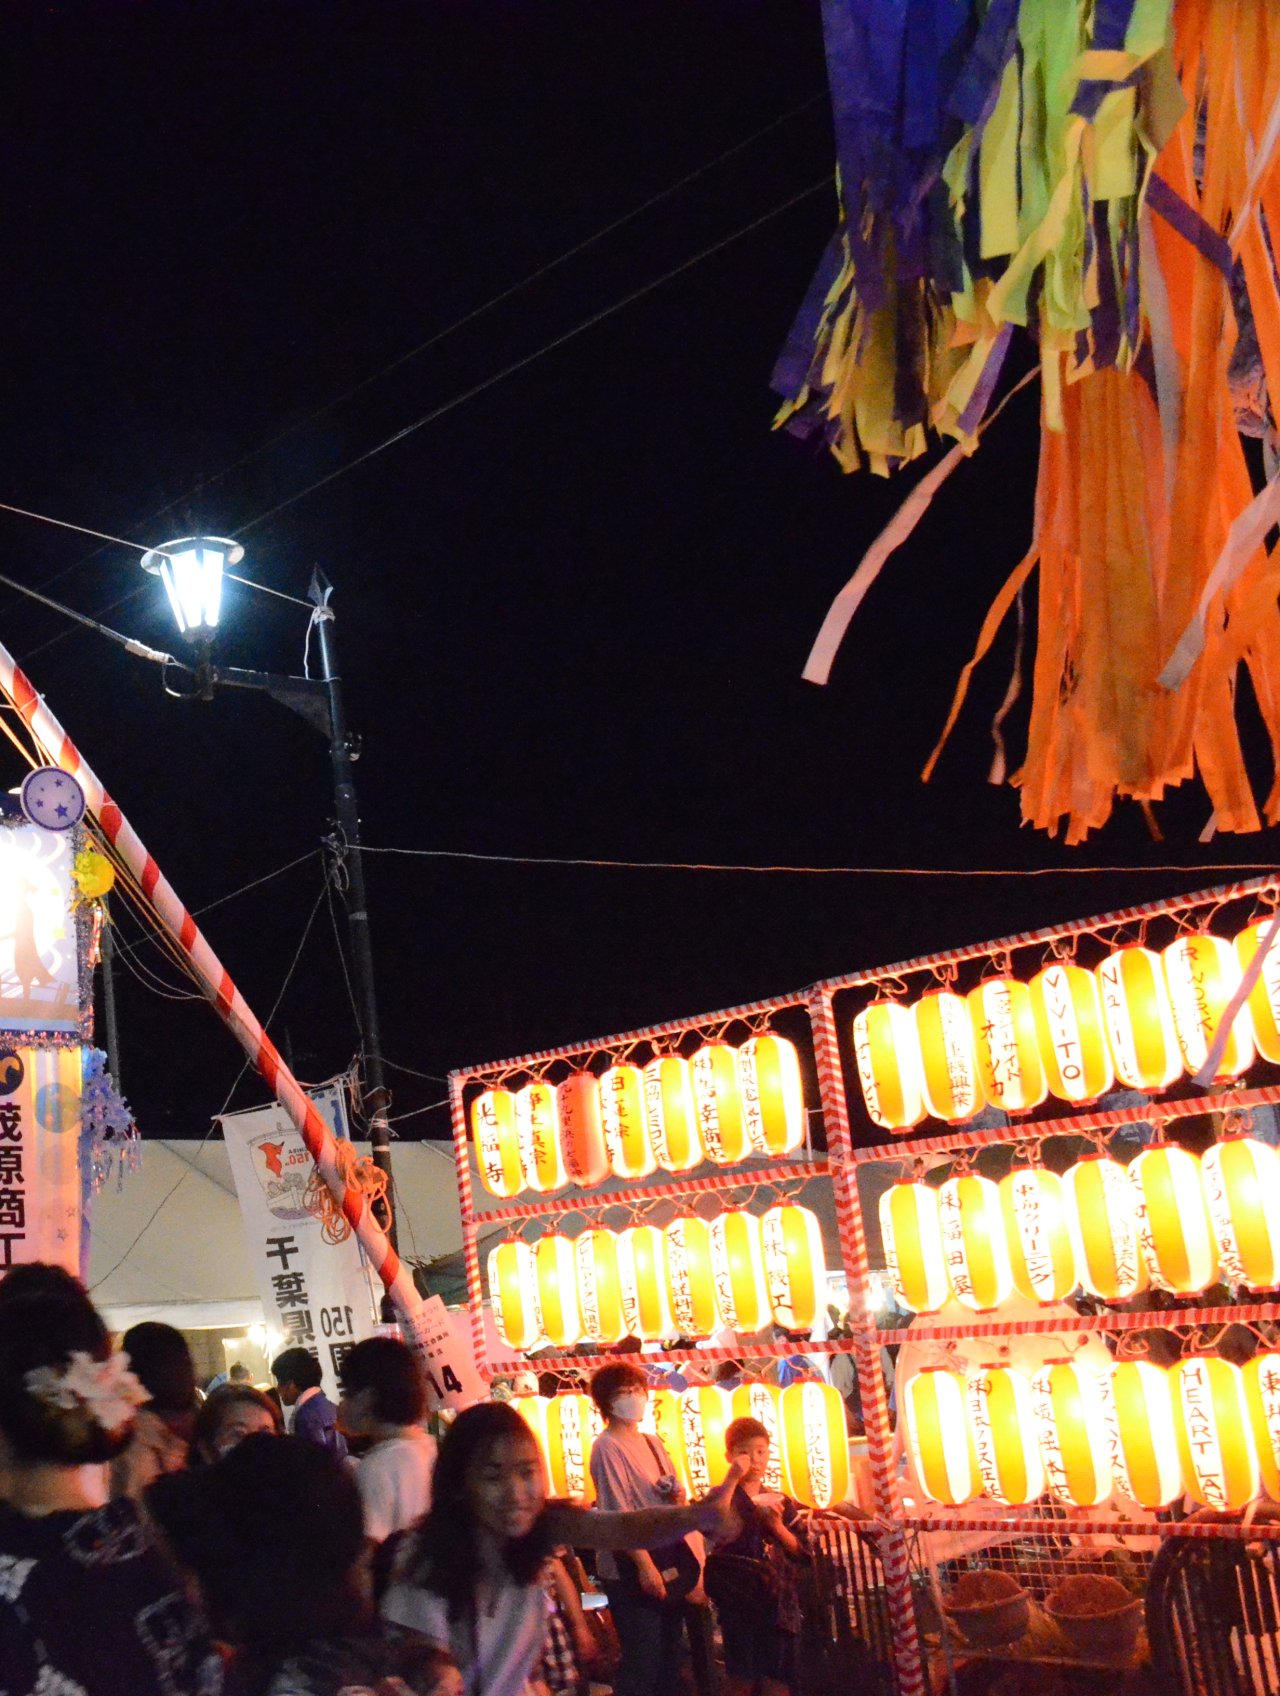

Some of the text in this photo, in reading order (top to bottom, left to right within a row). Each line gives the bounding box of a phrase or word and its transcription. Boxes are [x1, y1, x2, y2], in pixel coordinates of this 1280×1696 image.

[980, 1019, 1004, 1096] オーツカ
[477, 1102, 504, 1183] 光福寺
[610, 1076, 630, 1139] 日蓮宗
[424, 1364, 463, 1400] 14
[1181, 1367, 1213, 1454] HEART
